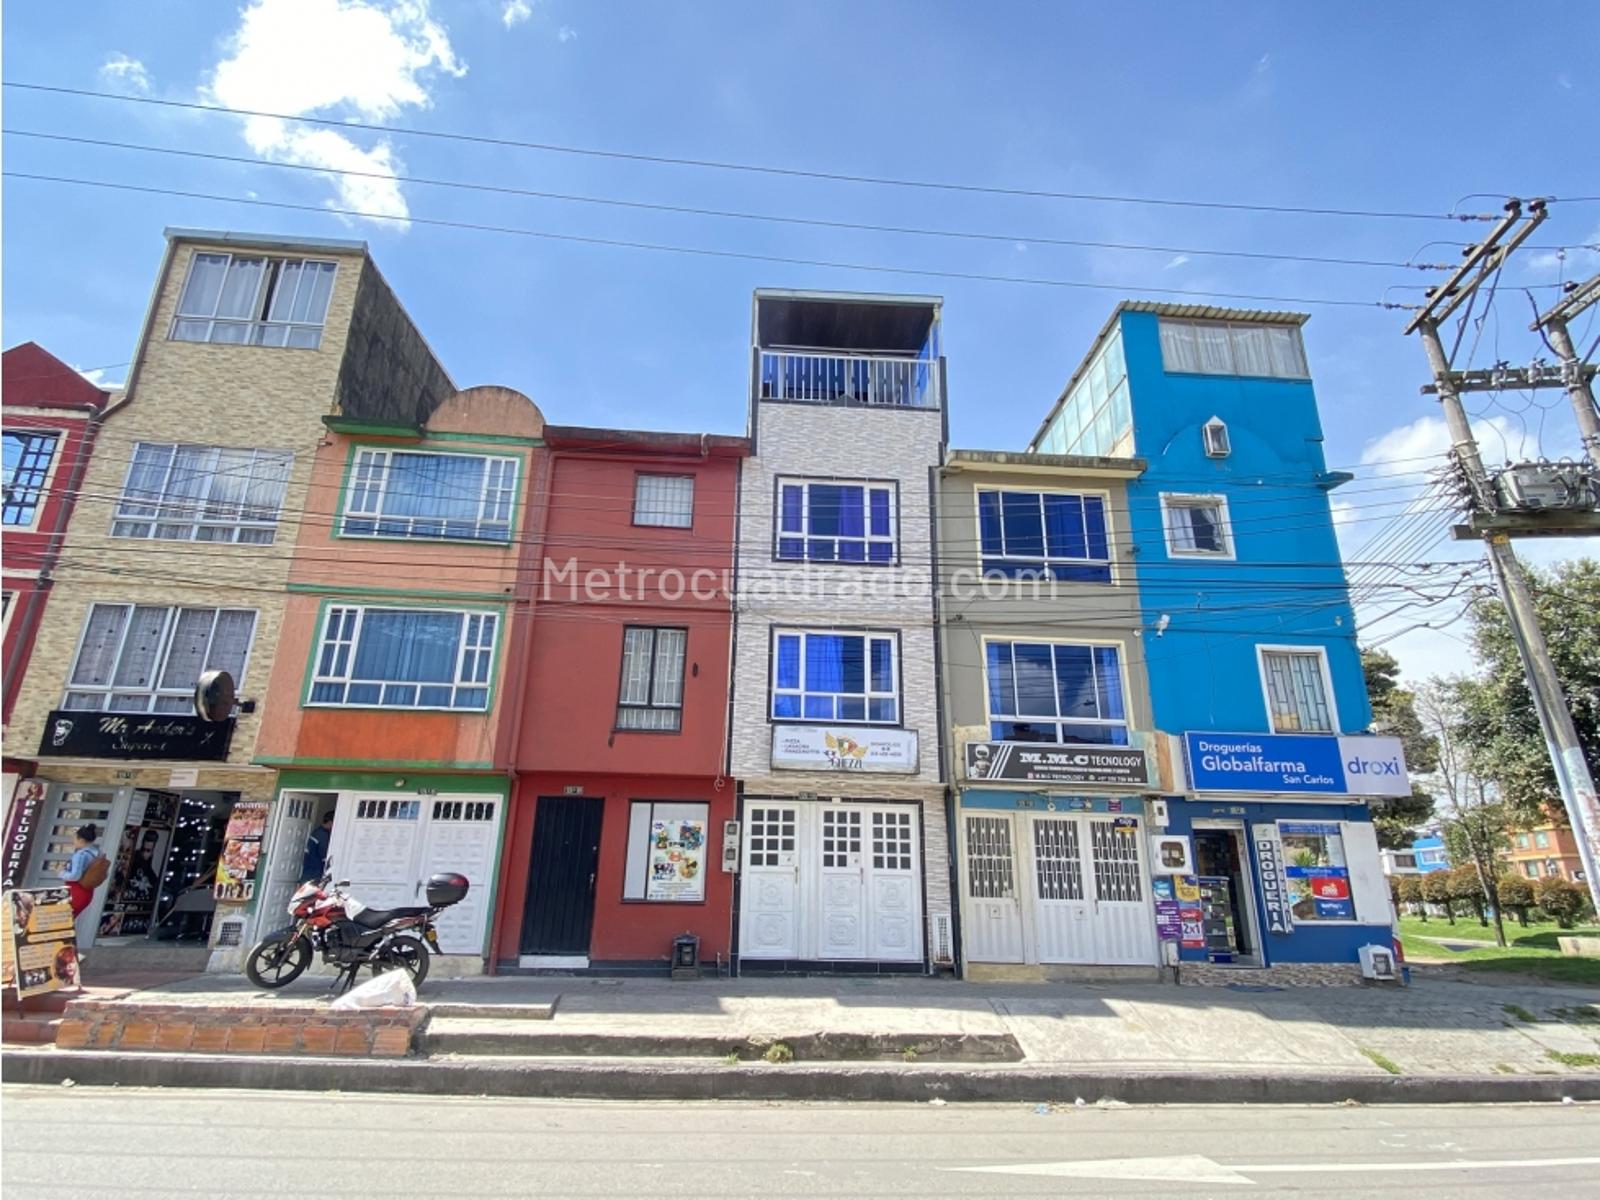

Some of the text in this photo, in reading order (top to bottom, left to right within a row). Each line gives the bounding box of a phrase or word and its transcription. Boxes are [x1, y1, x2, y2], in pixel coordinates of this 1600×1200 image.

[1199, 741, 1262, 755] Droguerías
[1019, 752, 1141, 768] M.M.C TECNOLOGY
[1202, 755, 1306, 773] Globalfarma
[1347, 756, 1400, 776] droxi
[1282, 774, 1334, 785] San Carlos
[1257, 840, 1285, 932] DROGUERIA
